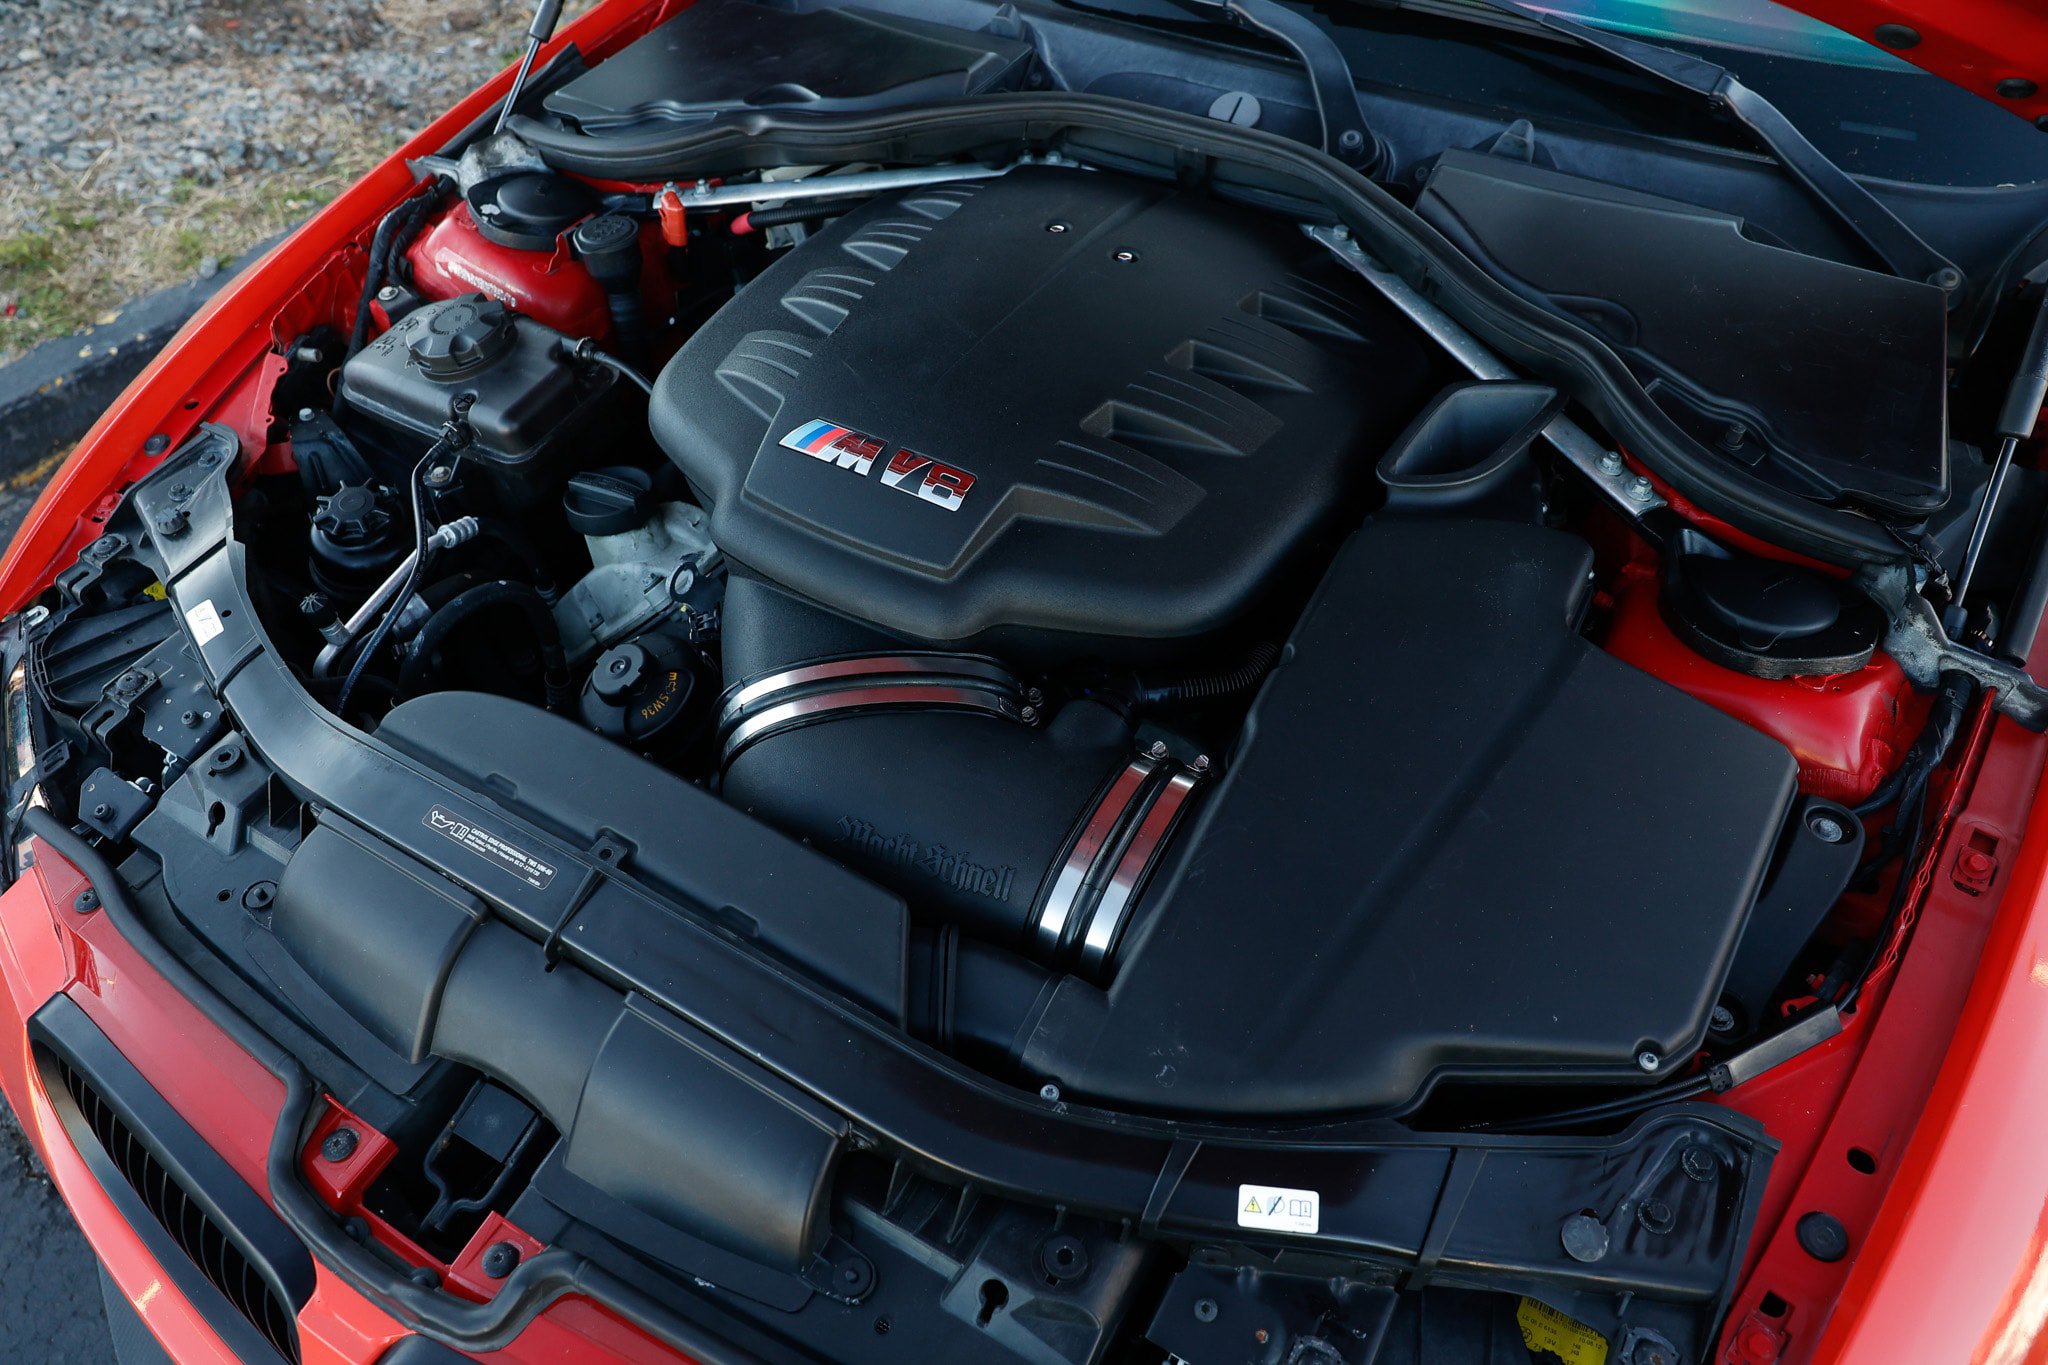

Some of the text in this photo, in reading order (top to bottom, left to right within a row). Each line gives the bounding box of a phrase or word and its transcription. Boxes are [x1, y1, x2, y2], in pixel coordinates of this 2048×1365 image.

[879, 447, 978, 512] V8
[470, 827, 490, 841] CASTROL
[498, 842, 528, 863] PROFESSIONAL
[918, 844, 1016, 902] Schnell
